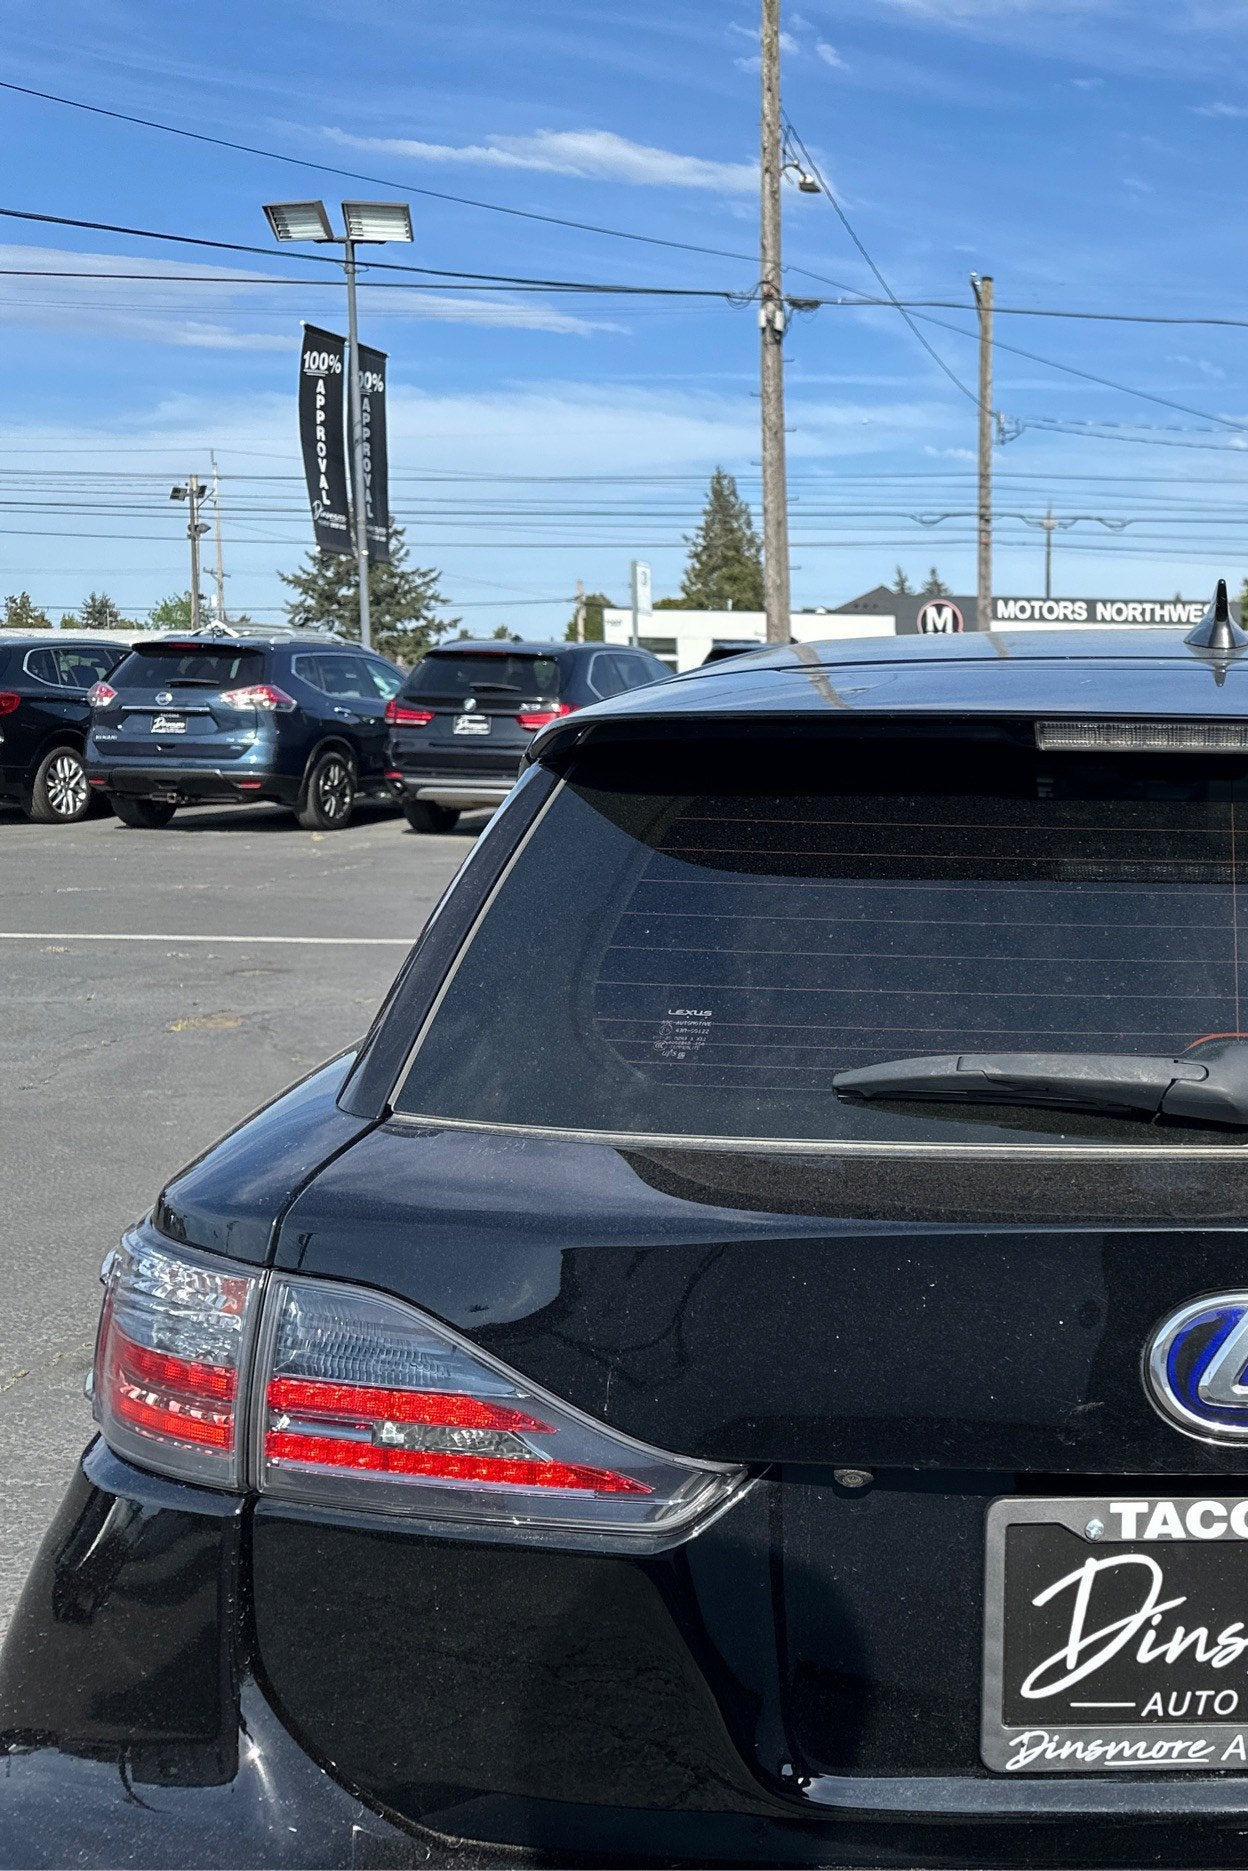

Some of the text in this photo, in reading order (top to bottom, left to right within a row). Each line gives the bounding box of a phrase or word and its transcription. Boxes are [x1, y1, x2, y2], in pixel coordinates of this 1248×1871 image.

[303, 350, 342, 374] 100%
[358, 371, 384, 392] 00%
[315, 378, 331, 505] APPROVAL
[361, 397, 374, 518] APPROVAL
[997, 600, 1087, 621] MOTORS
[1141, 1691, 1239, 1717] AUTO
[1005, 1730, 1216, 1771] Dinsmore
